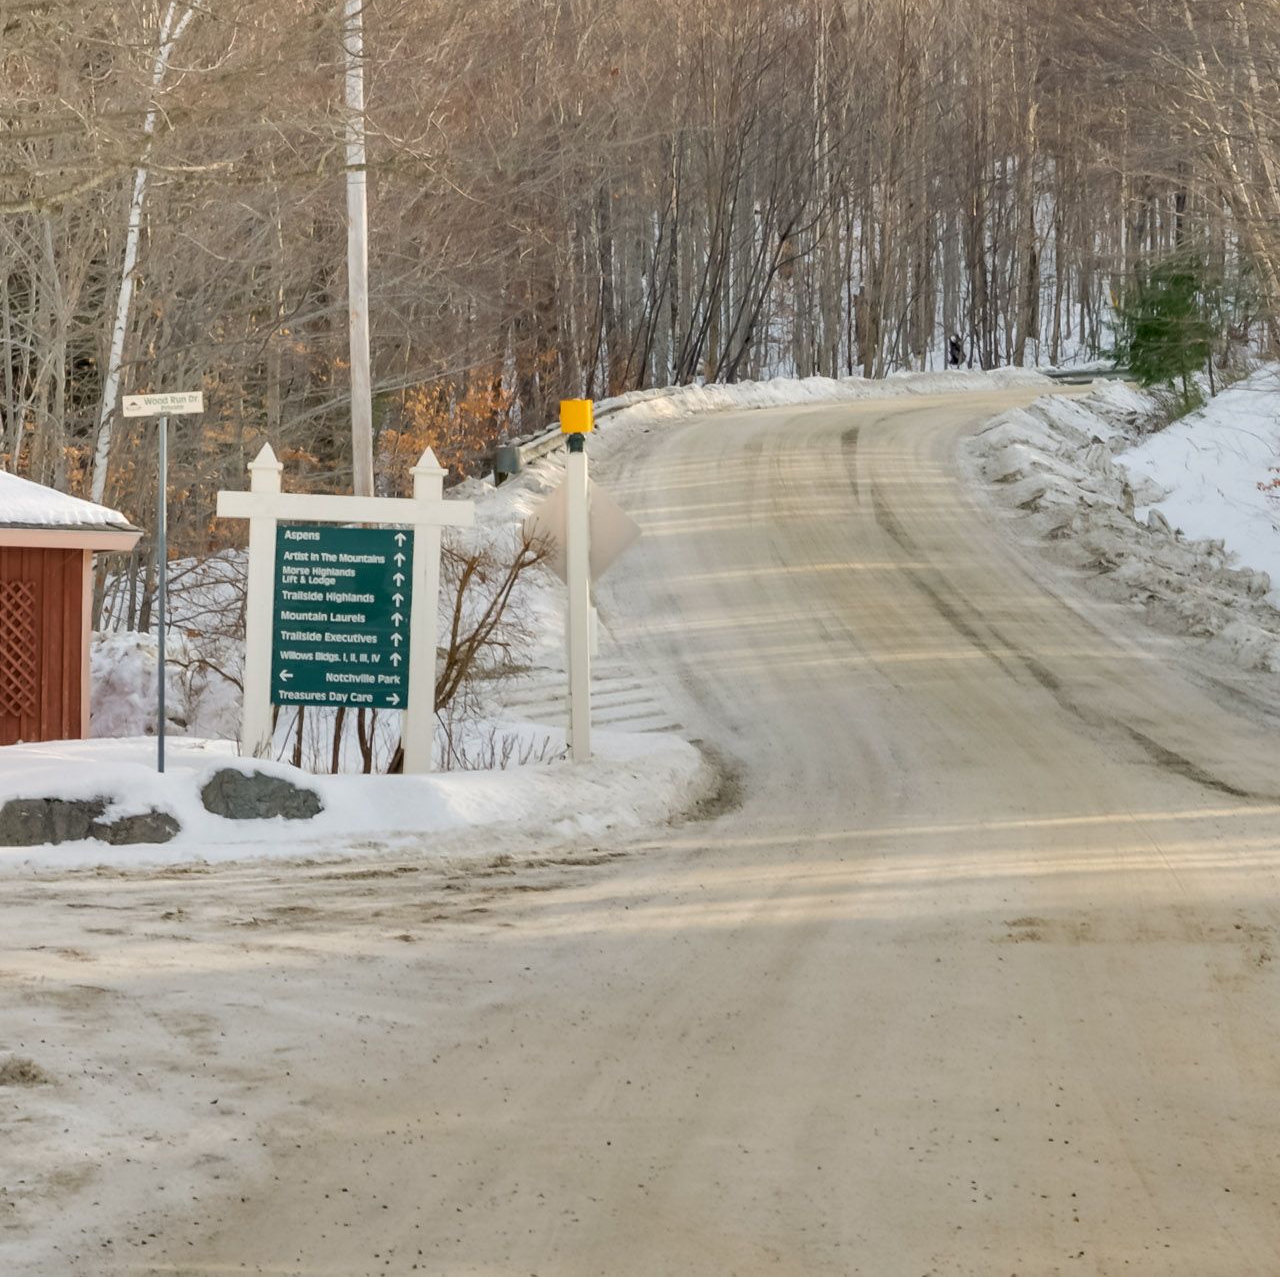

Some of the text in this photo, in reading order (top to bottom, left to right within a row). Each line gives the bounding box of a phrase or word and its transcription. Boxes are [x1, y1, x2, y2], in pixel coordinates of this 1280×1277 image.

[144, 396, 168, 405] Wood
[170, 395, 186, 404] Run
[284, 530, 320, 541] Aspens
[283, 551, 386, 564] Artist In The Mountains
[282, 566, 356, 578] Morse Highlands
[282, 575, 336, 586] Lift & Lodge
[282, 590, 375, 603] Trailside Highlands
[281, 610, 366, 623] Mountain Laurels
[281, 630, 377, 644] Trailside Executives
[280, 651, 314, 661] Willows
[315, 652, 341, 663] Bldgs.
[371, 654, 381, 663] IV
[325, 672, 401, 685] Notchville Park
[278, 690, 374, 703] Treasures Day Care
